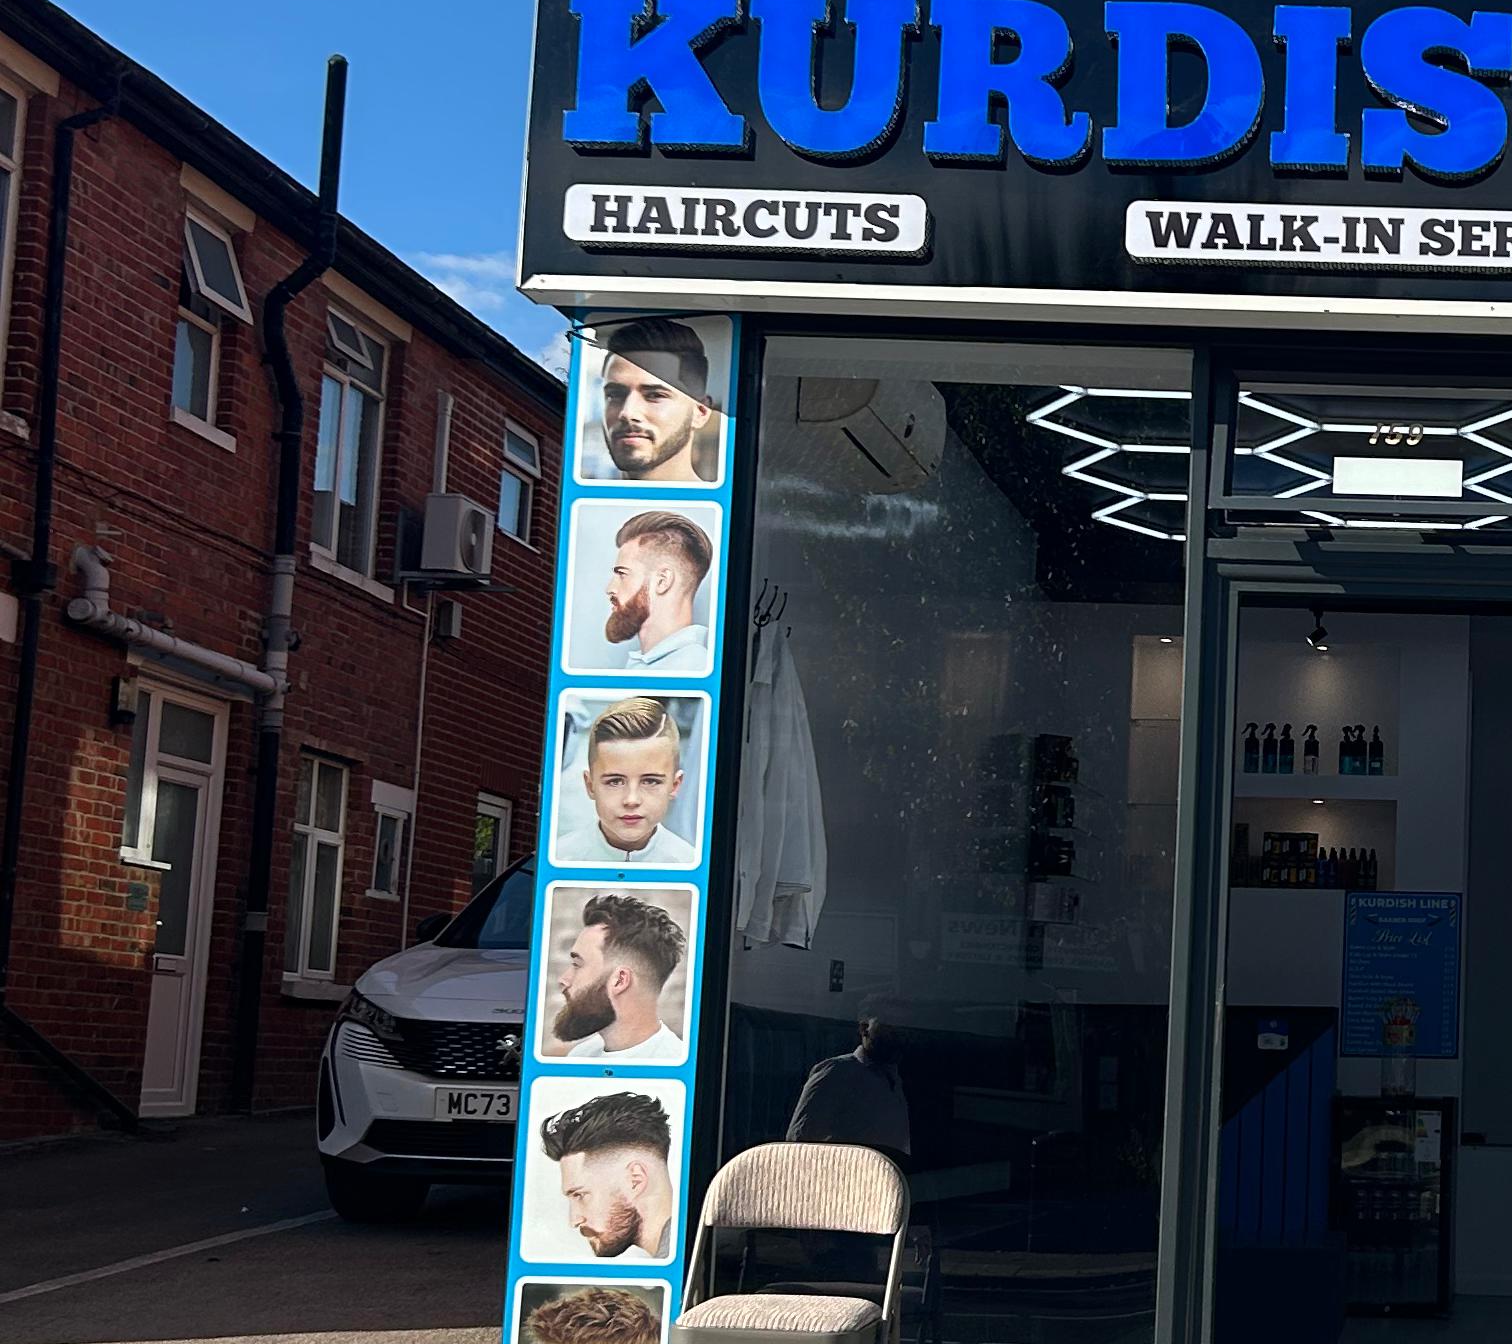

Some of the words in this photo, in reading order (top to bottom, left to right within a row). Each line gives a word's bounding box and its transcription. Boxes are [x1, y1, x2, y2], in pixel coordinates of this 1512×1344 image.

[590, 194, 900, 242] HAIRCUTS
[1145, 211, 1405, 255] WALK-IN
[1369, 422, 1424, 446] 159
[1358, 898, 1417, 908] KURDISH
[447, 1093, 511, 1117] MC73
